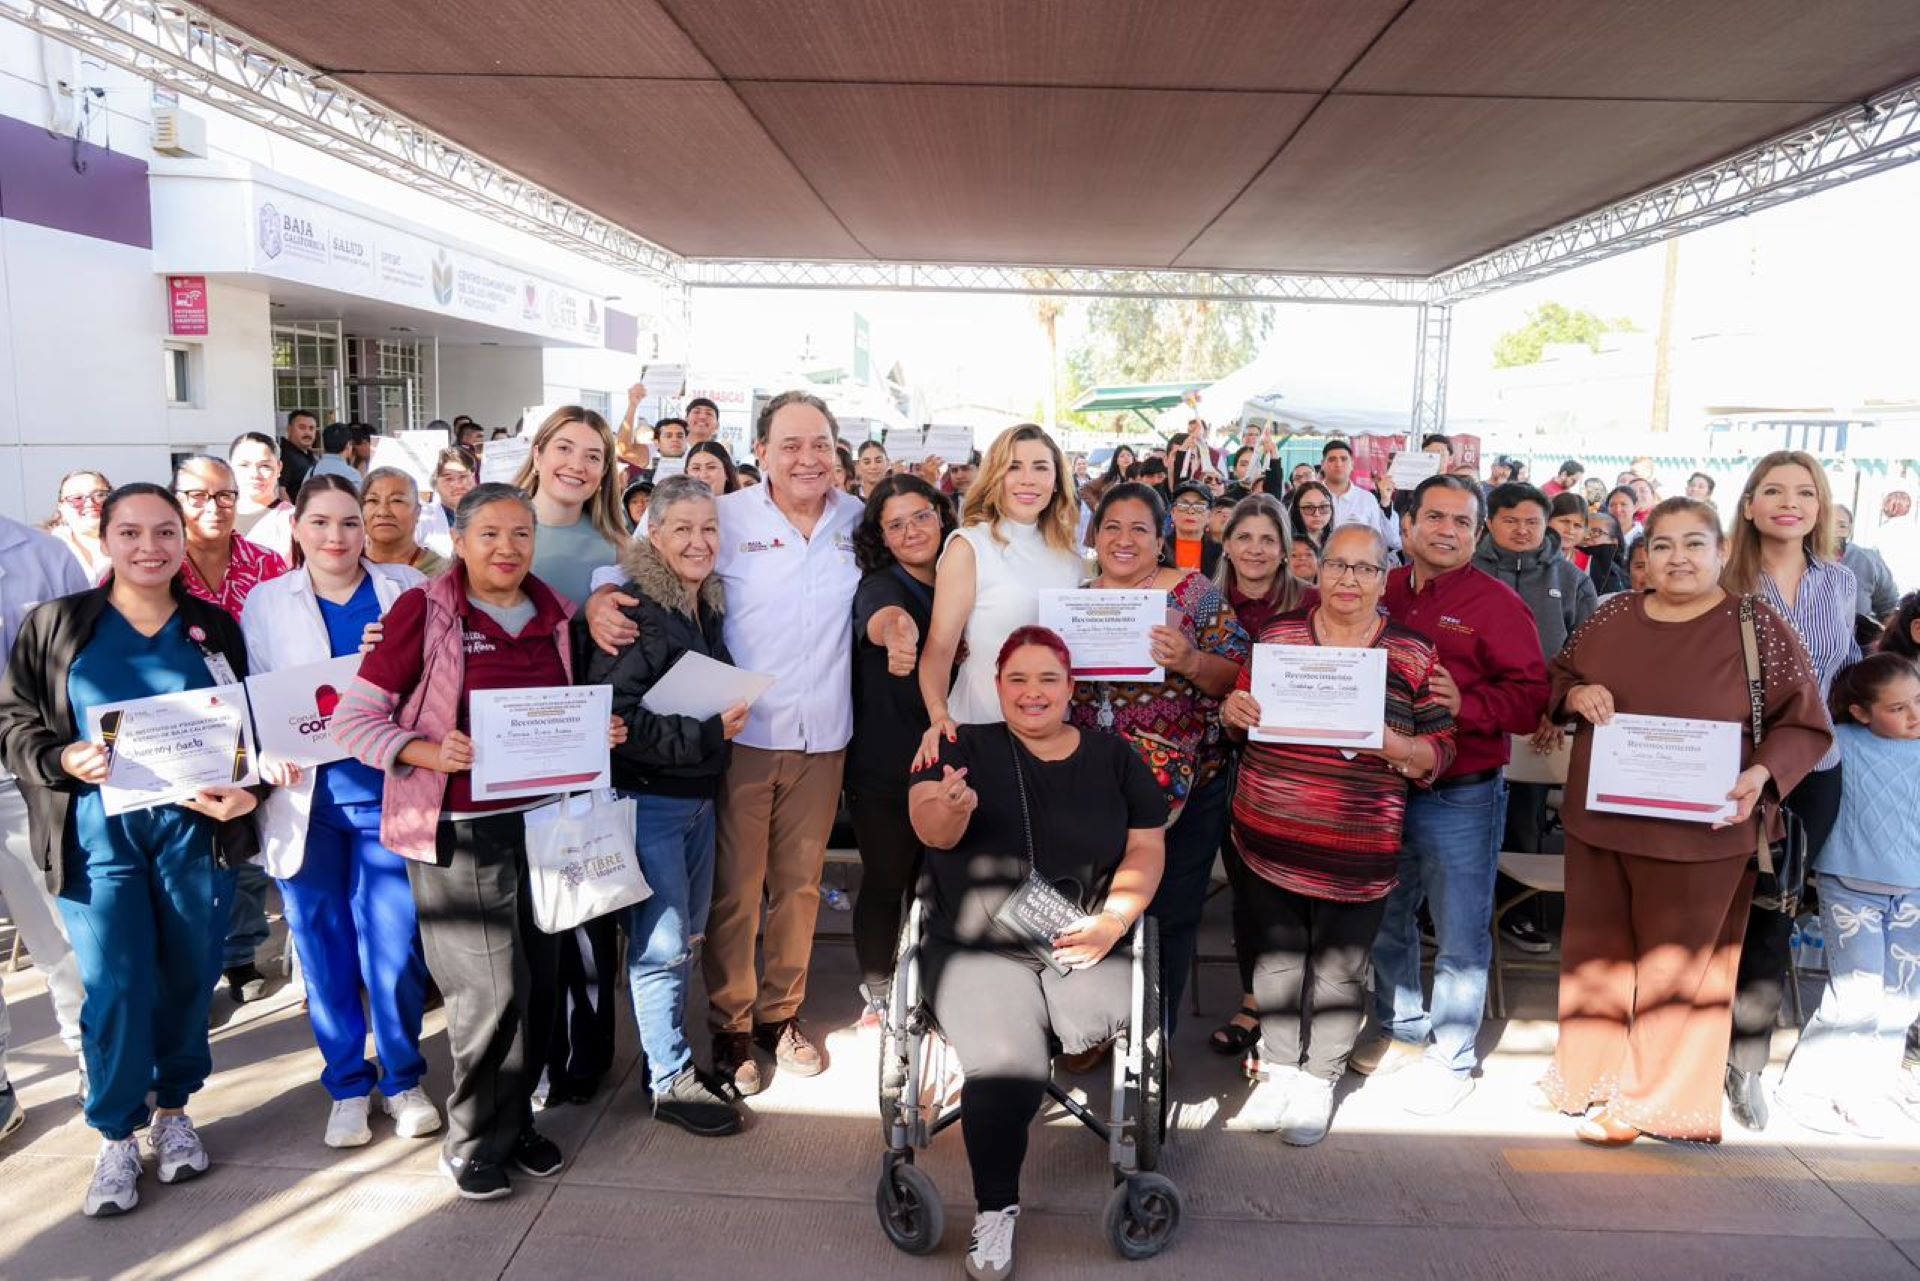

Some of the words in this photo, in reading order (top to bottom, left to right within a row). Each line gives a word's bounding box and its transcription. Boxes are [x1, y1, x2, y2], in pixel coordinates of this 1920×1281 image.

[283, 215, 314, 238] BAJA
[283, 231, 326, 252] CALIFORNIA
[333, 236, 365, 257] SALUD
[1071, 616, 1136, 624] Reconocimiento
[1284, 671, 1353, 681] Reconocimiento
[510, 716, 581, 727] Reconocimiento
[1627, 739, 1702, 753] Reconocimiento
